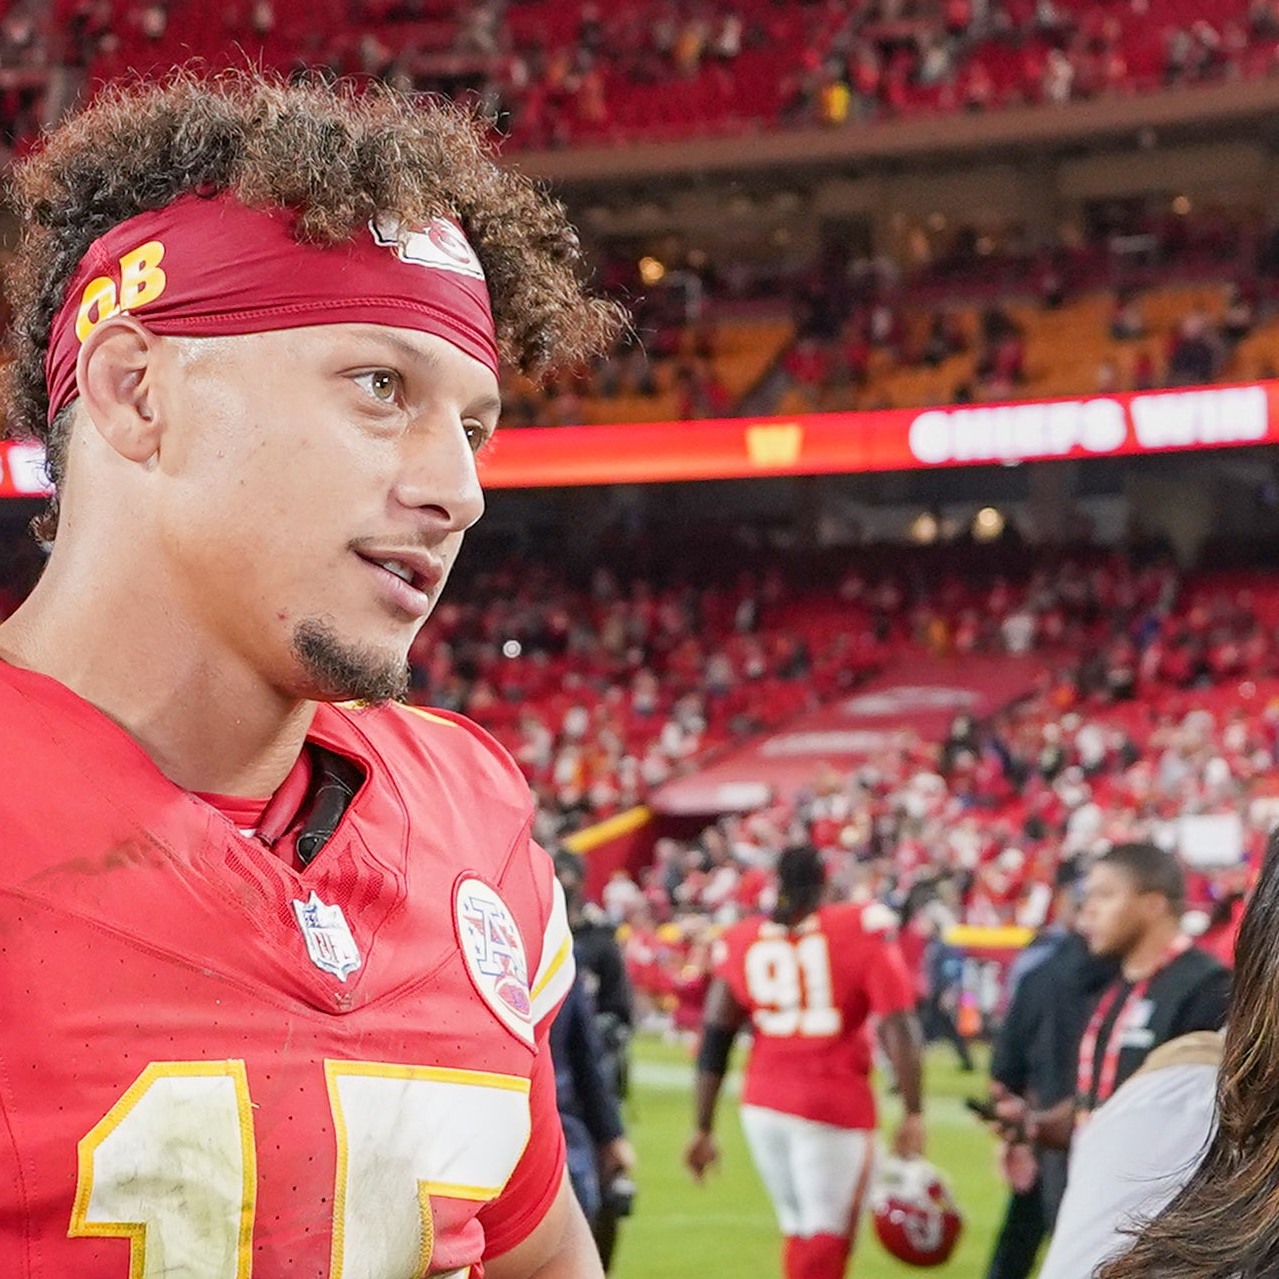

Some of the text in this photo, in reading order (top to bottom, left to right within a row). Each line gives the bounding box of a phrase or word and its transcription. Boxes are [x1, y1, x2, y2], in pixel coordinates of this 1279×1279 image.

[75, 240, 166, 343] QB
[909, 385, 1268, 464] CHIEFS WIN
[745, 933, 842, 1039] 91
[67, 1058, 532, 1279] 15
